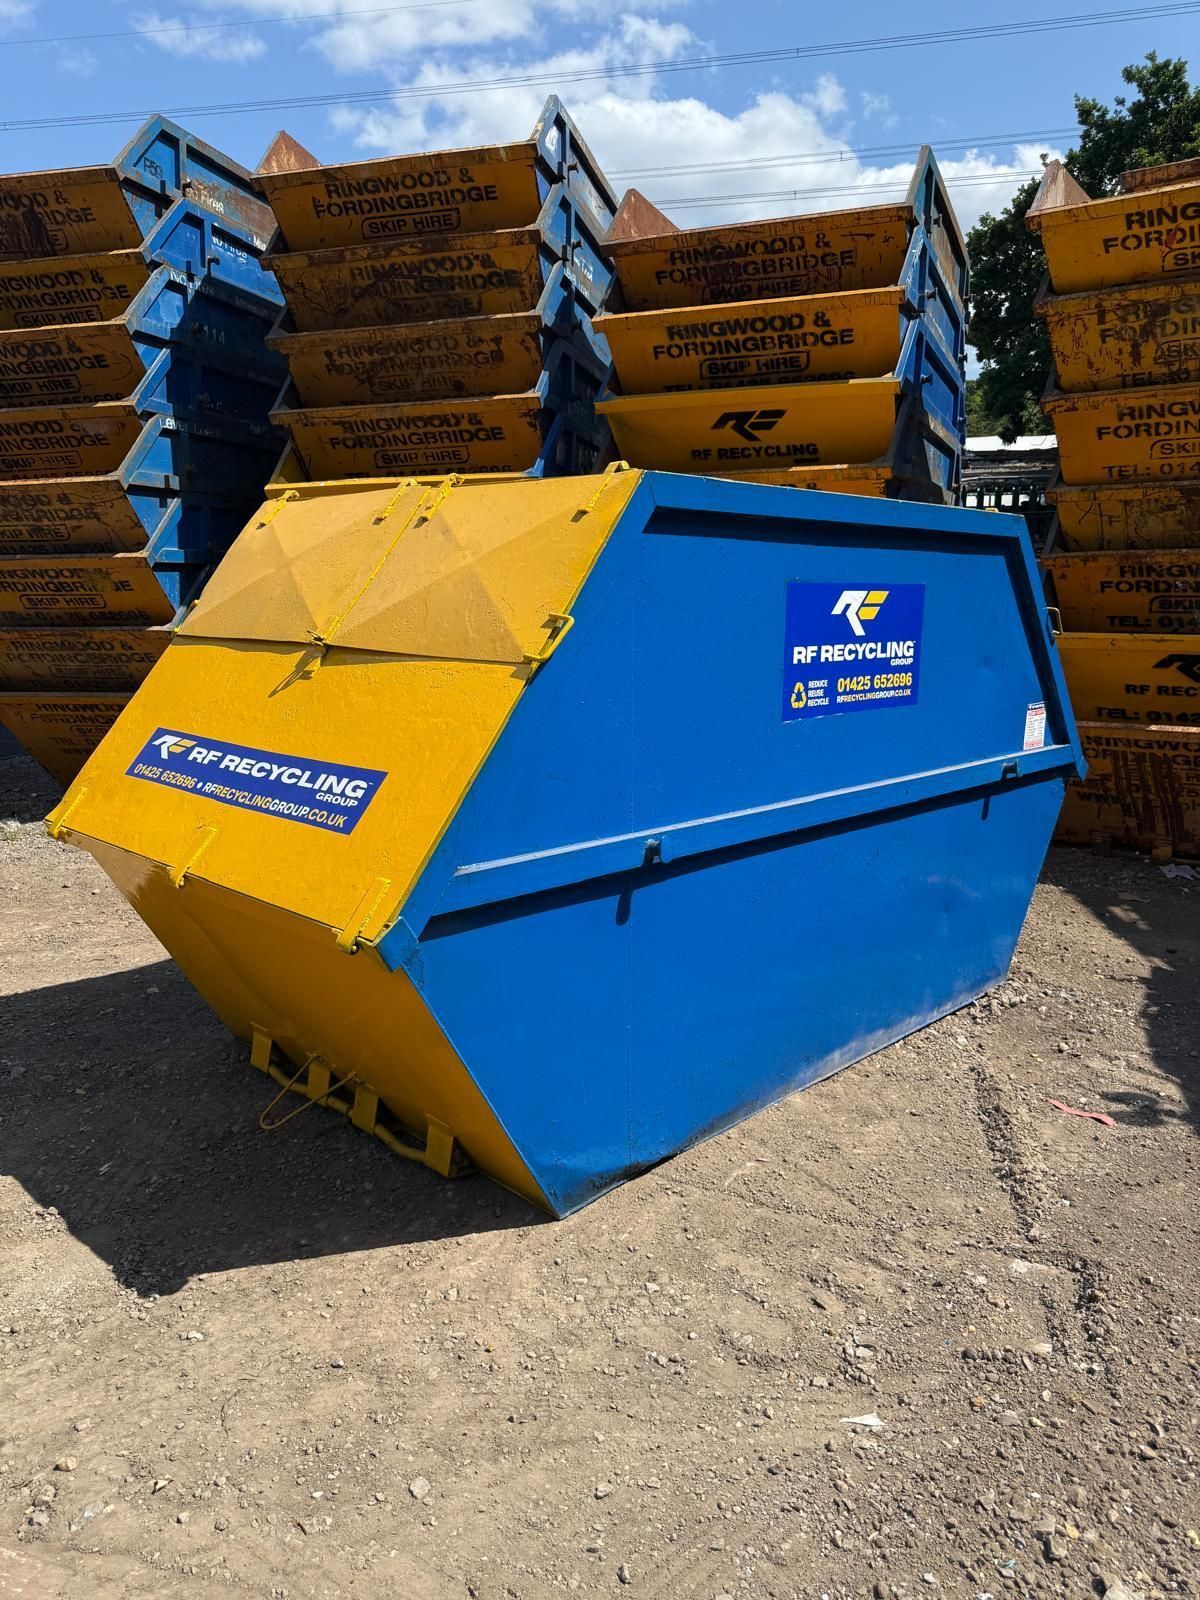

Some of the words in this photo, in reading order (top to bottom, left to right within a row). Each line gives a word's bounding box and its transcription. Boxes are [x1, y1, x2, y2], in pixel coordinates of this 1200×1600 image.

[324, 170, 451, 199] RINGWOOD
[458, 167, 476, 184] &
[0, 191, 49, 210] OOD
[54, 189, 71, 205] &
[312, 184, 499, 219] FORDINGBRIDGE
[368, 218, 408, 235] SKIP
[413, 214, 454, 231] HIRE
[669, 235, 806, 265] RINGWOOD
[815, 231, 832, 248] &
[1102, 224, 1200, 255] FORDI
[655, 249, 857, 285] FORGBRIDGE
[666, 312, 805, 341] RINGWOOD
[812, 310, 832, 328] &
[652, 328, 855, 361] FORDINGBRIDGE
[707, 360, 751, 376] SKIP
[755, 355, 802, 371] HIRE
[36, 378, 76, 392] HIRE
[0, 420, 64, 437] WOOD
[340, 413, 461, 434] RINGWOOD
[1096, 418, 1200, 440] FORDIN
[329, 426, 505, 450] FORDINGBRIDGE
[381, 451, 418, 465] SKIP
[422, 449, 463, 462] HIRE
[690, 449, 713, 461] RF
[717, 443, 819, 460] RECYCLING
[1102, 464, 1152, 479] TEL:
[64, 596, 101, 606] HIRE
[1106, 615, 1152, 628] TEL:
[792, 645, 819, 665] RF
[820, 641, 915, 663] RECYCLING
[890, 658, 914, 666] GROUP
[808, 680, 829, 689] REDUCE
[837, 676, 871, 693] 01425
[873, 672, 913, 689] 652696
[1124, 683, 1151, 695] RF
[1156, 684, 1200, 697] REC
[807, 689, 825, 698] REUSE
[807, 698, 830, 707] RECYCLE
[836, 689, 912, 704] RFRECYCLINGGROUP.CO.UK
[1095, 705, 1141, 721] TEL:
[187, 746, 223, 765] RF
[218, 754, 368, 799] RECYCLING
[133, 763, 162, 779] 01425
[160, 768, 196, 790] 652696
[202, 781, 349, 828] RFRECYCLINGGROUP.CO.UK
[315, 791, 360, 808] GROUP
